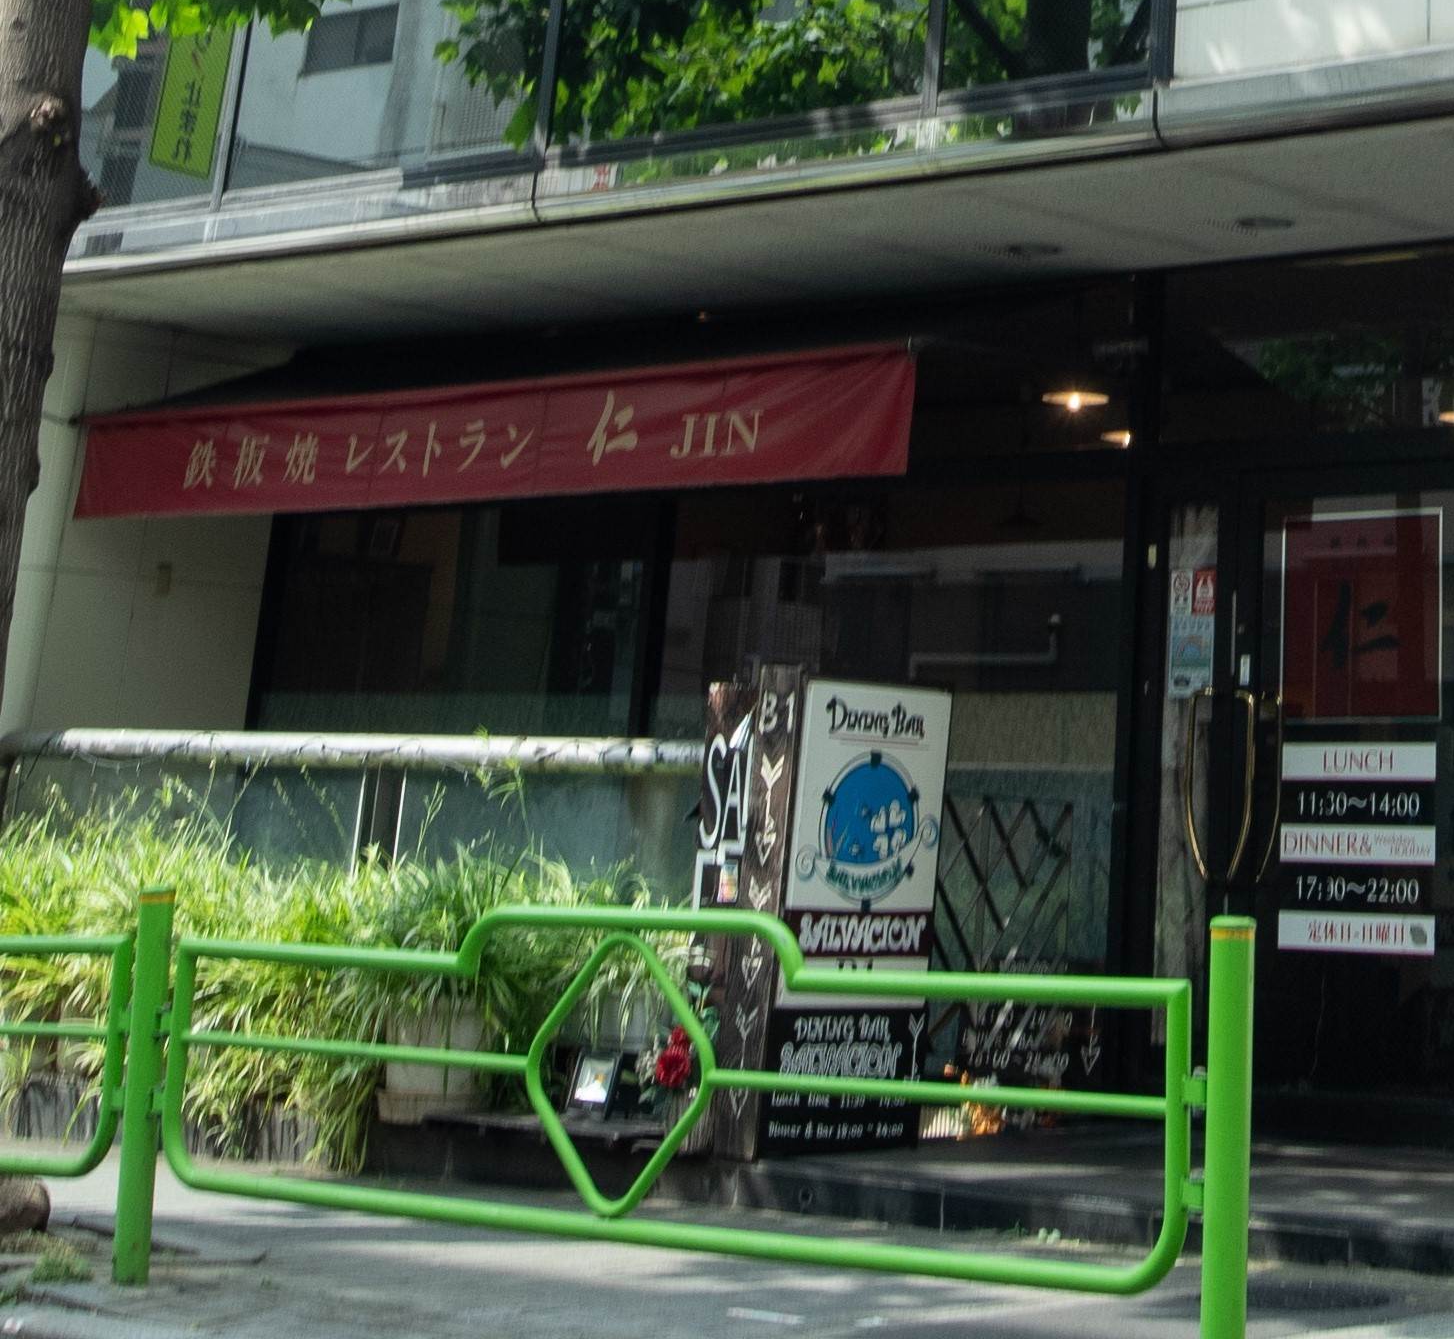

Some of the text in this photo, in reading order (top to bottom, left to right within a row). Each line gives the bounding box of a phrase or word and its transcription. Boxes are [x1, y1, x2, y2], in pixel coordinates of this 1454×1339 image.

[182, 389, 765, 491] 鉄板焼レストラン 仁 JIN
[758, 689, 796, 736] B1
[1323, 750, 1394, 774] LUNCH
